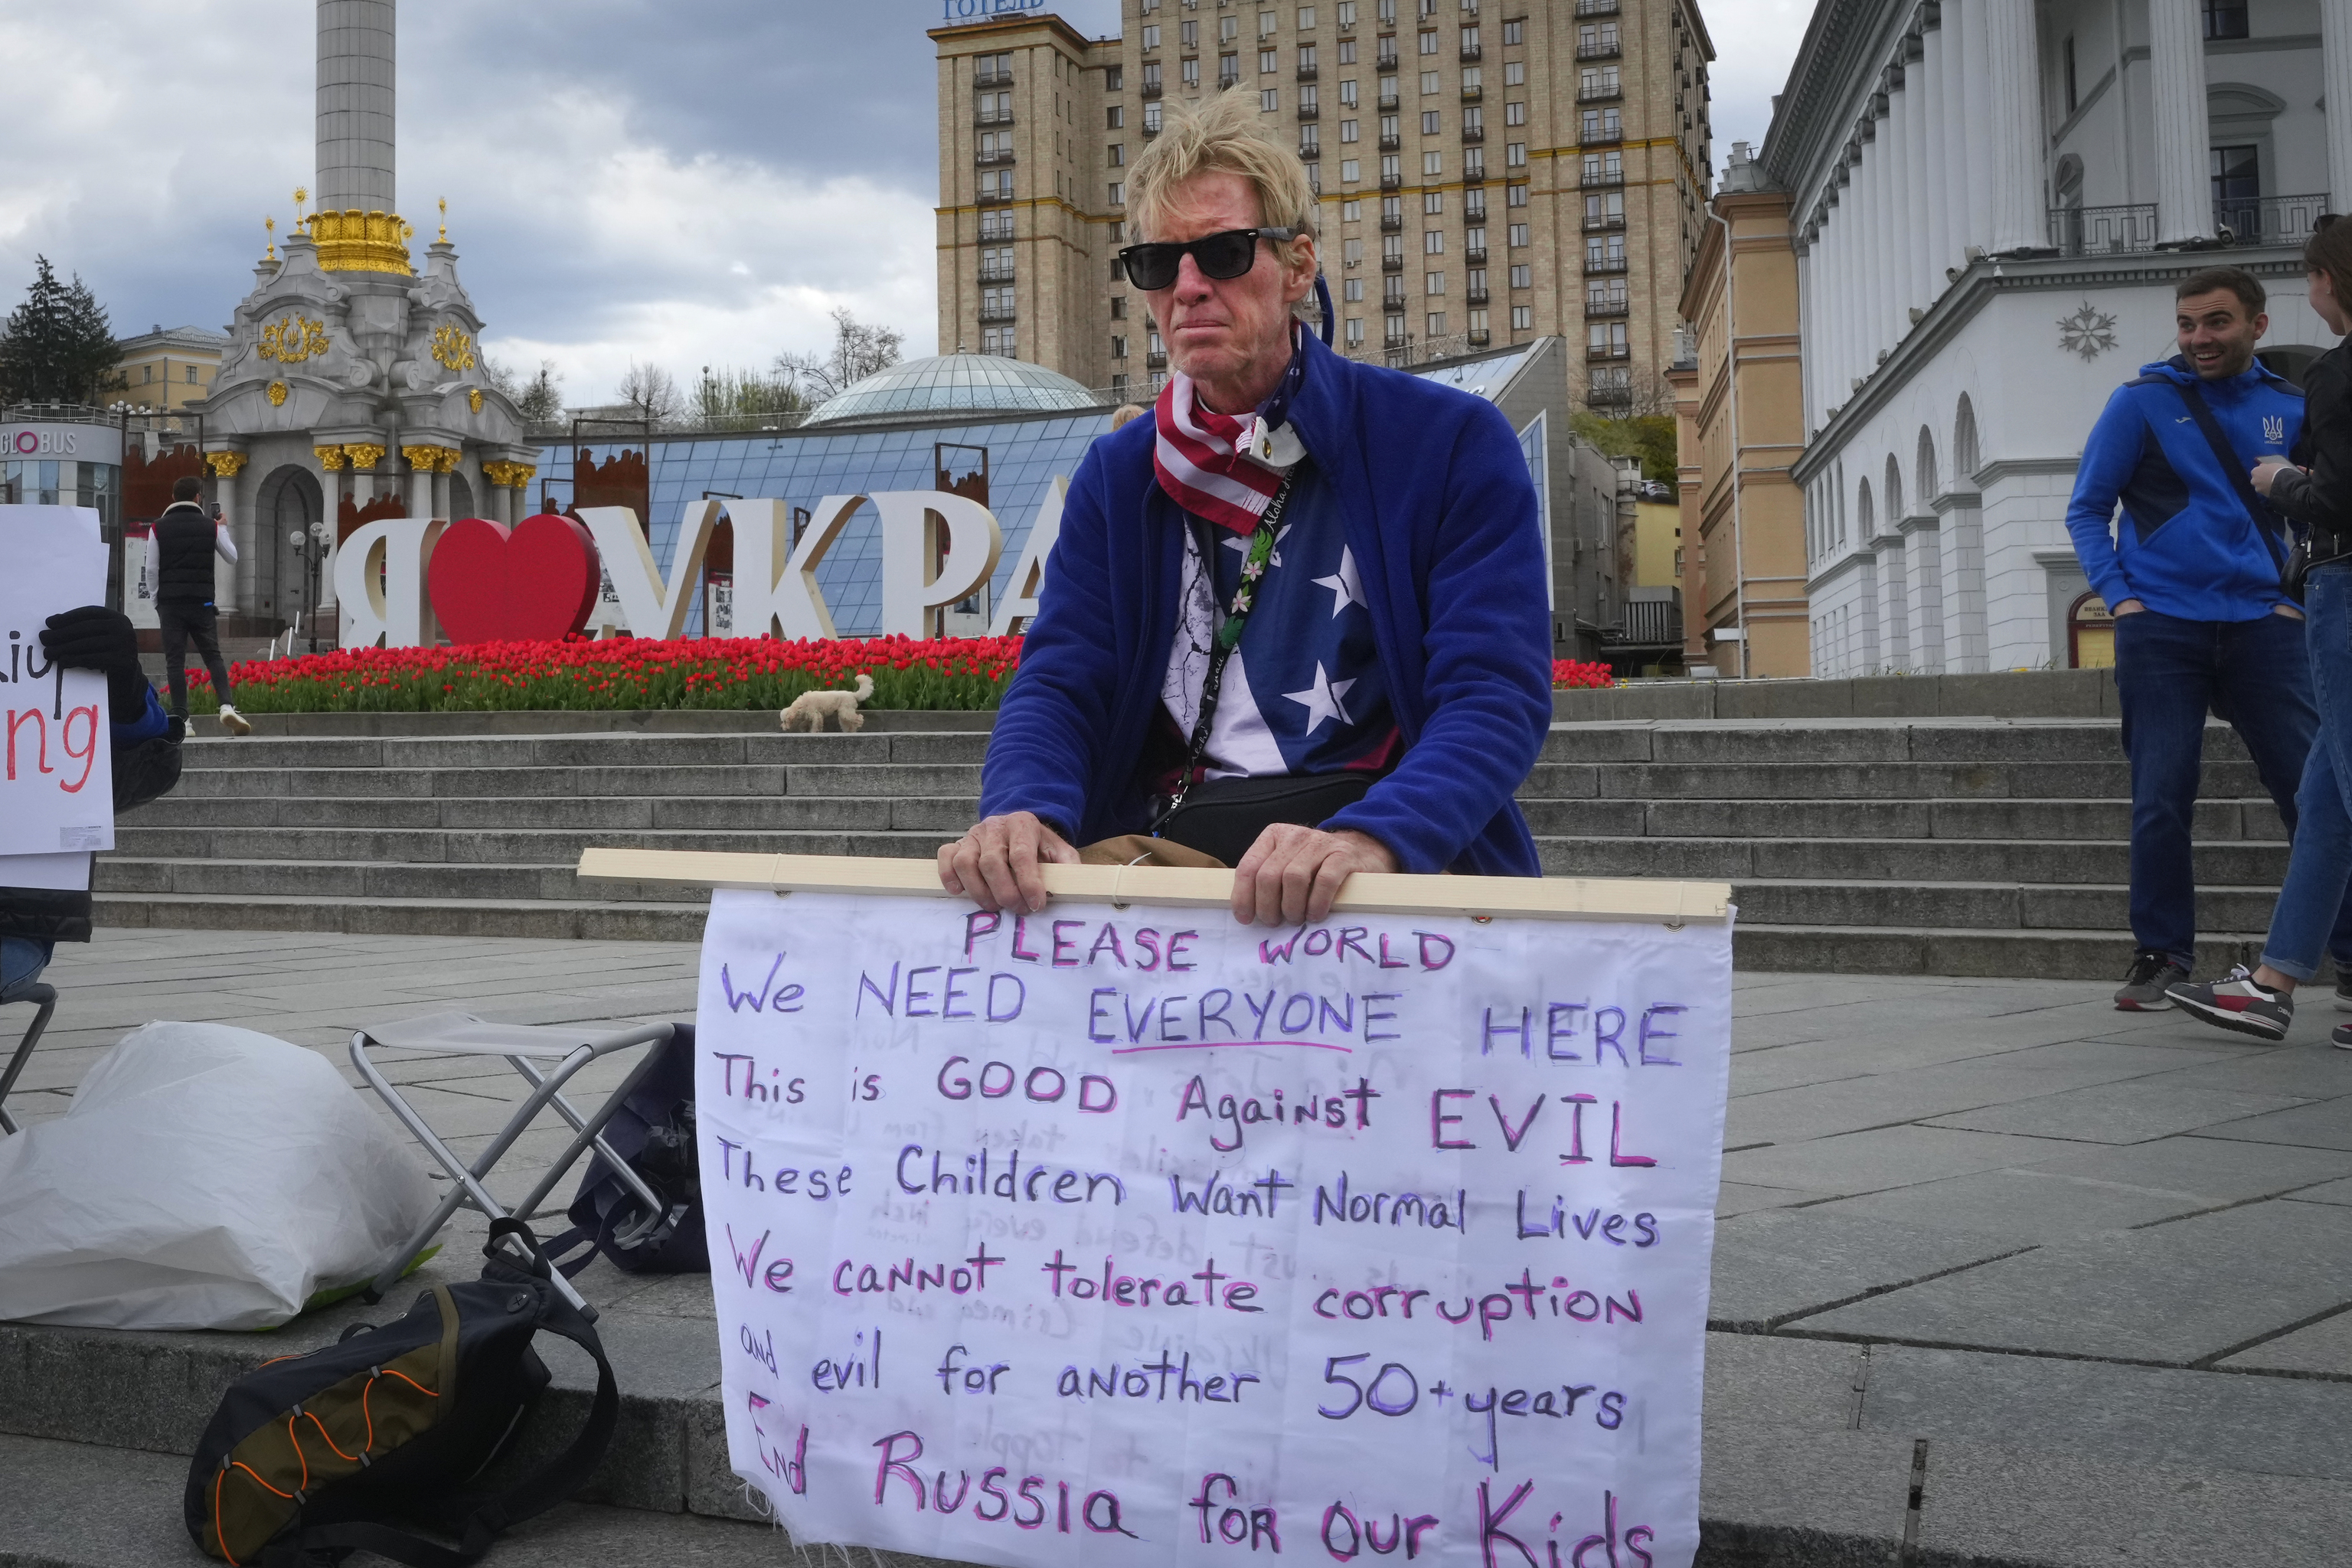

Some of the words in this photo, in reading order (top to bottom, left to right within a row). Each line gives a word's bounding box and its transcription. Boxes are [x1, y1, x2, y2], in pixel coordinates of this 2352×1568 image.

[1, 431, 76, 454] GLOBUS
[1264, 490, 1287, 534] Aloha
[334, 515, 448, 655] Я
[963, 911, 1200, 972] PLEASE
[1259, 925, 1455, 972] WORLD
[720, 951, 805, 1014] We
[855, 961, 1026, 1024] NEED
[1087, 986, 1406, 1044] EVERYONE
[1481, 1002, 1690, 1067] HERE
[713, 1051, 806, 1104] This
[851, 1066, 882, 1102] is
[937, 1056, 1118, 1113] GOOD
[1432, 1088, 1658, 1168] EVIL
[716, 1135, 852, 1200] These
[897, 1145, 1126, 1205] Children
[1172, 1169, 1294, 1215] Want
[1313, 1171, 1465, 1235] Normal
[1517, 1189, 1660, 1247] Lives
[727, 1223, 794, 1294] We
[1041, 1248, 1267, 1312] tolerate
[812, 1327, 882, 1393] evil
[935, 1344, 1011, 1395] for
[1321, 1501, 1439, 1562] Our
[1476, 1477, 1654, 1568] Kids
